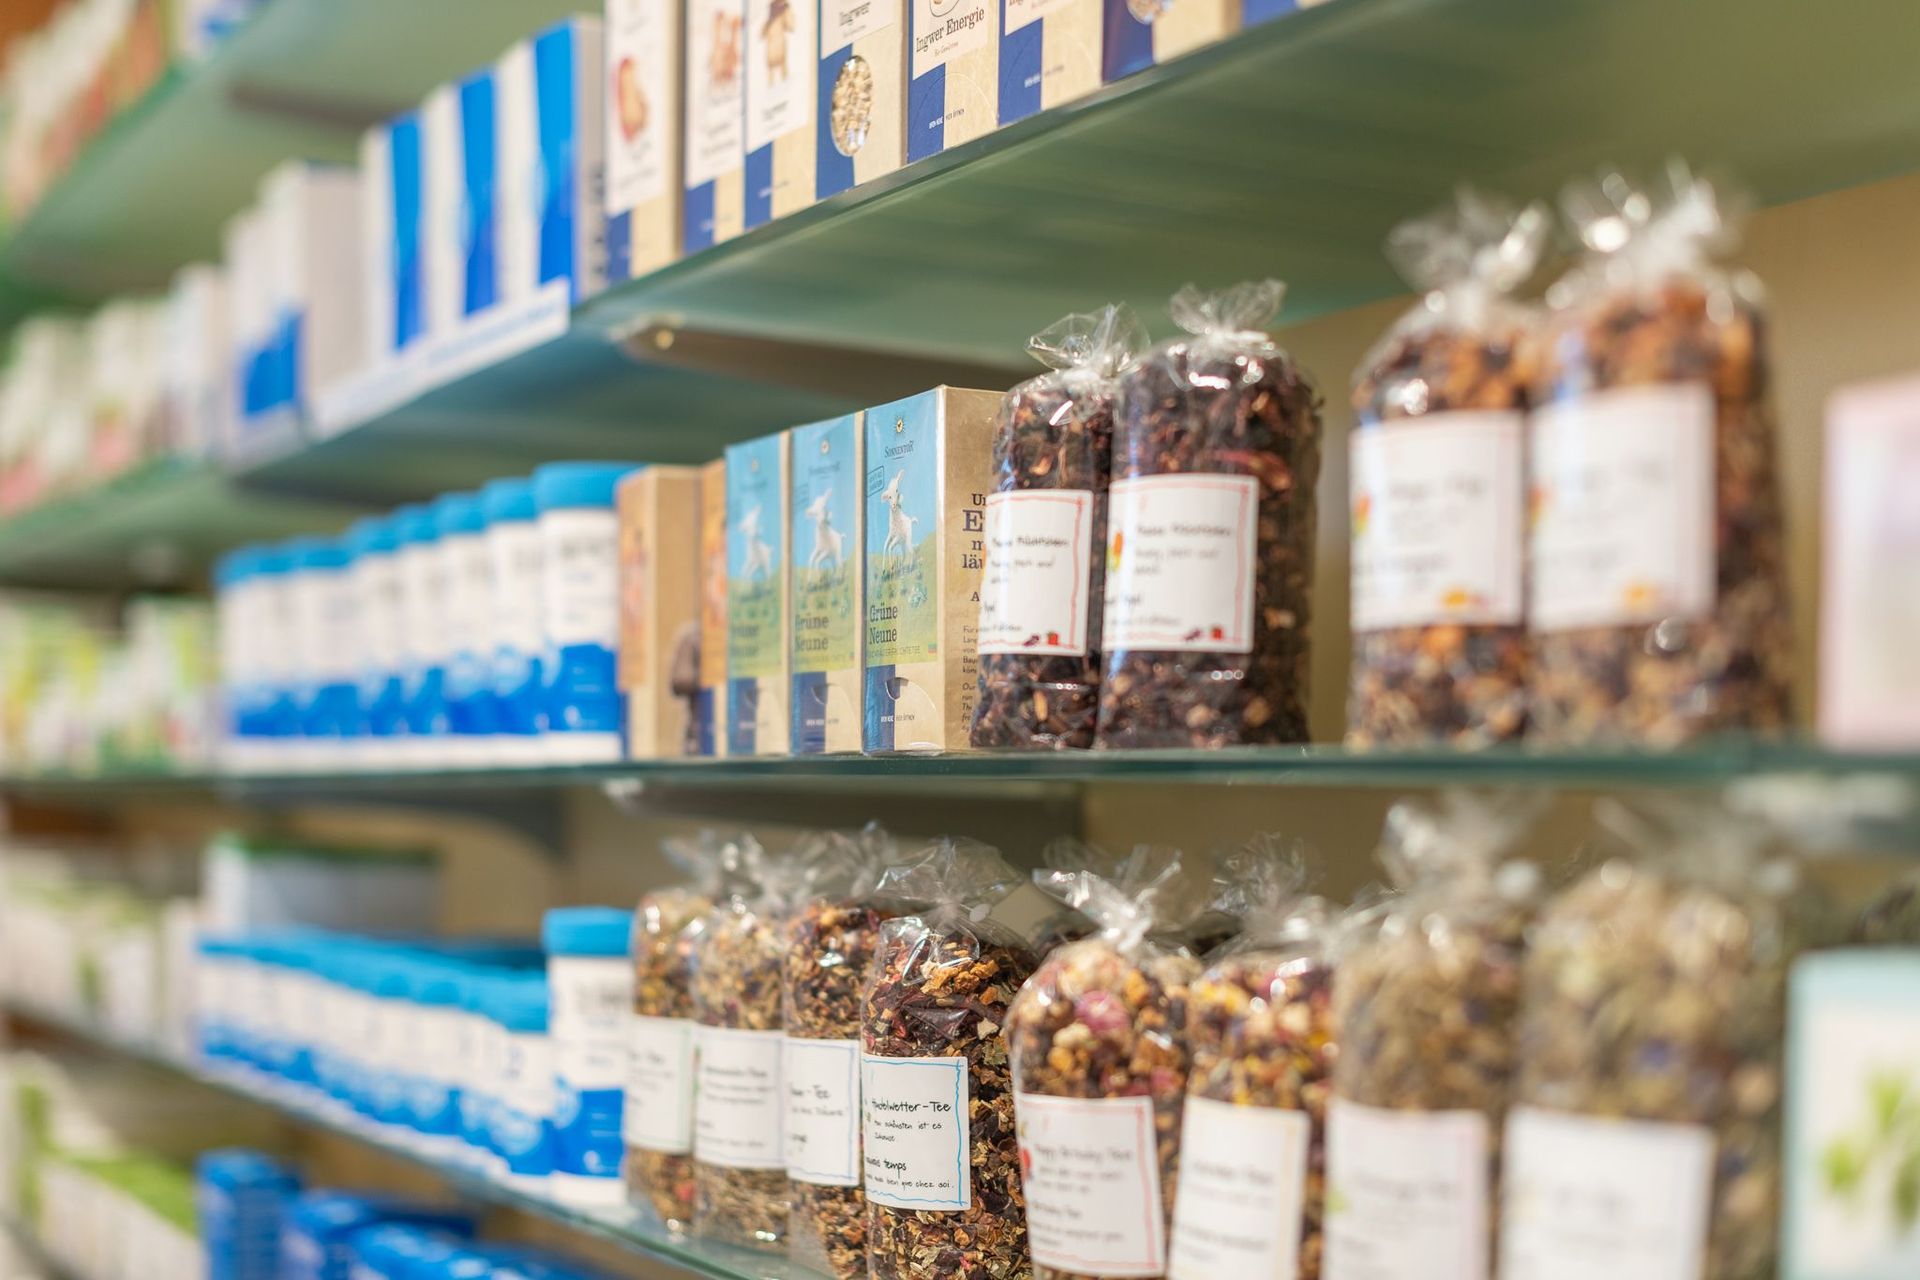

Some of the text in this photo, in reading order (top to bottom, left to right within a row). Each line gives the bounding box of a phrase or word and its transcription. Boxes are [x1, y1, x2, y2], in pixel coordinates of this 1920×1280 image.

[916, 26, 944, 53] Ingwer
[946, 5, 985, 36] Energie
[868, 602, 898, 622] Grüne
[869, 626, 897, 645] Neune
[883, 1158, 907, 1178] temps
[915, 1179, 935, 1188] chez
